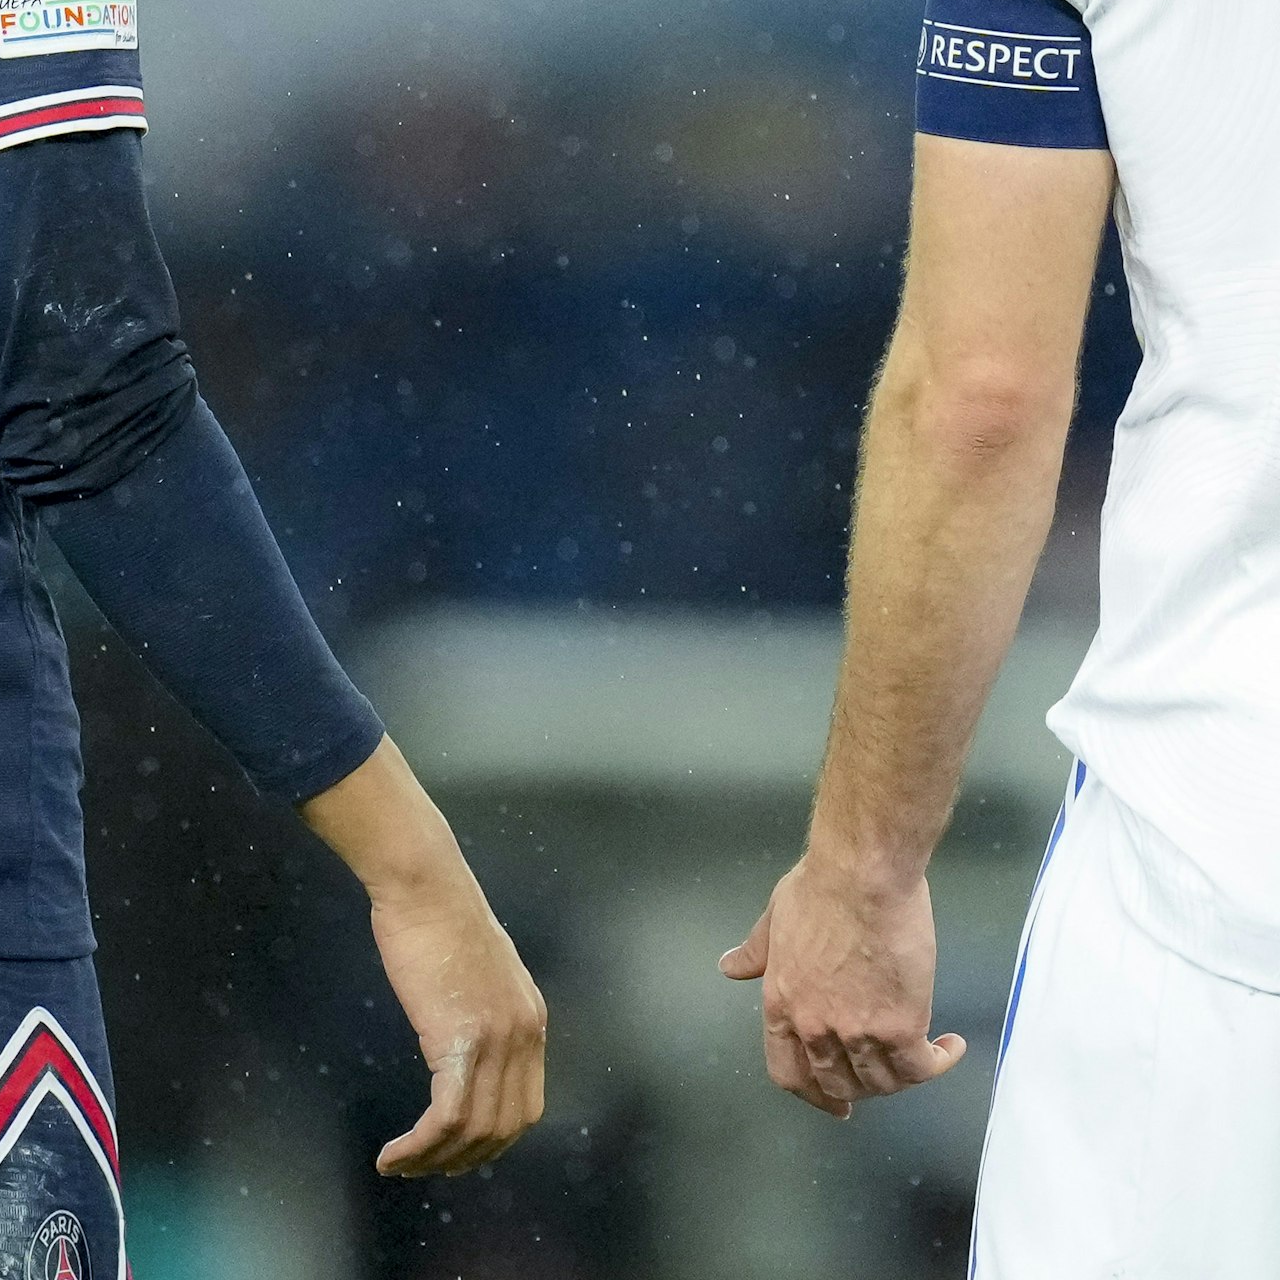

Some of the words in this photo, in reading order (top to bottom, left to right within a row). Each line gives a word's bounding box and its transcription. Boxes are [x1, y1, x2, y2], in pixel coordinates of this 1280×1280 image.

[0, 4, 136, 35] FOUNDATION
[930, 34, 1082, 80] RESPECT
[39, 1215, 81, 1248] PARIS
